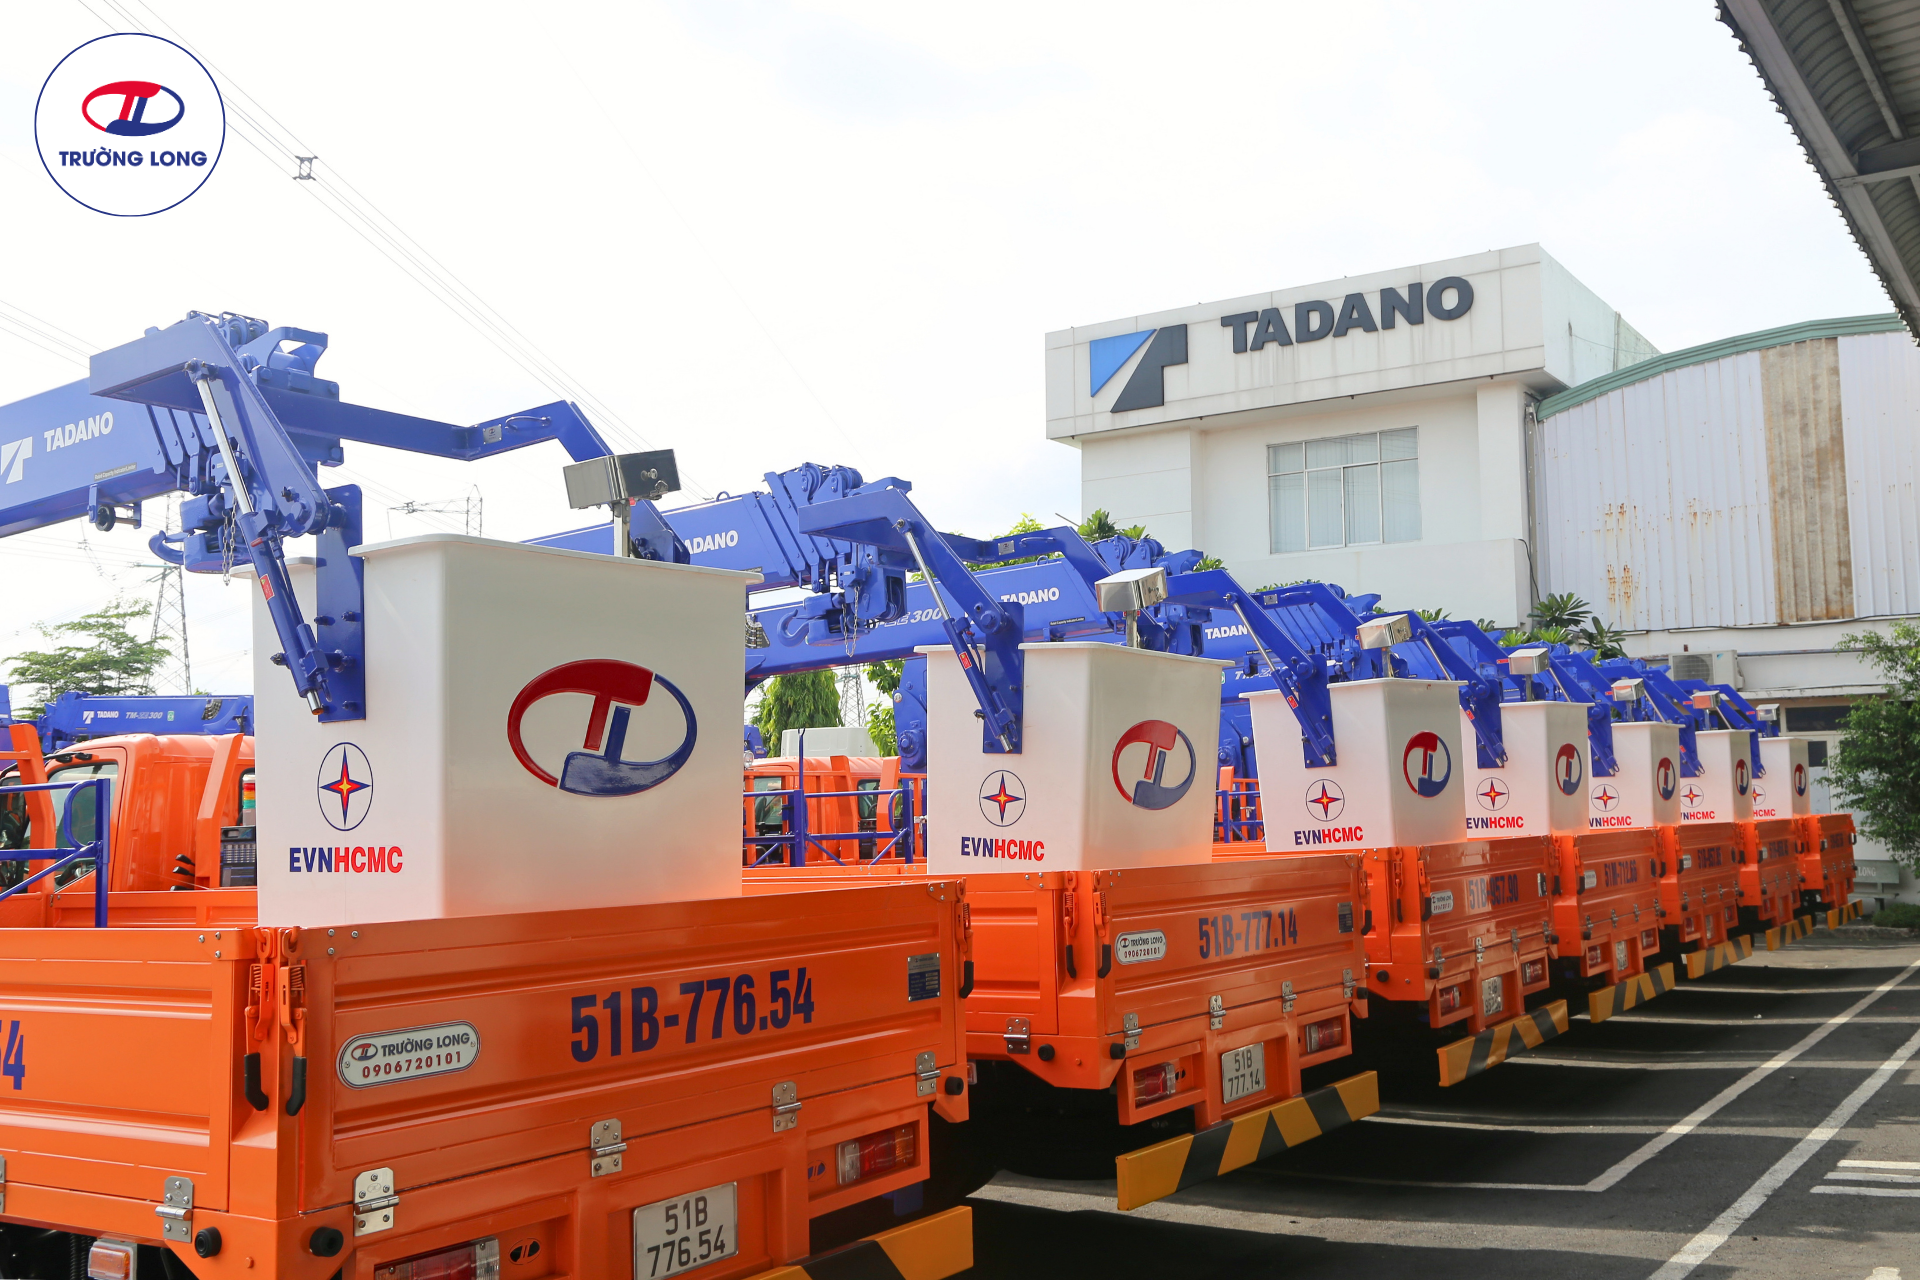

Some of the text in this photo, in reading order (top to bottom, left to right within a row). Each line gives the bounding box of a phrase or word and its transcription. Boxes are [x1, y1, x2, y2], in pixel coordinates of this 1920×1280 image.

[1220, 276, 1474, 354] TADANO
[43, 411, 114, 453] TADANO
[684, 530, 739, 555] ADANO
[1204, 624, 1249, 640] TADAN
[97, 711, 119, 719] TADANO
[1466, 816, 1524, 830] EVNHCMC
[1589, 815, 1632, 828] VNHCMC
[1681, 811, 1715, 821] NHCMC
[1753, 808, 1775, 818] HCMC
[961, 836, 1045, 862] EVNHCMC
[1294, 826, 1364, 846] EVNHCMC
[289, 846, 404, 874] EVNHCMC
[1858, 866, 1877, 877] LONG
[1468, 874, 1519, 910] 51B-957.90
[1198, 907, 1298, 960] 51B-777.14
[570, 967, 815, 1063] 51B-776.54
[0, 1019, 26, 1091] 4
[381, 1032, 470, 1057] TRƯỜNG LONG
[362, 1050, 461, 1079] 0906720101
[1234, 1049, 1253, 1073] 51B
[1227, 1068, 1261, 1098] 777.14
[664, 1195, 709, 1236] 51B
[647, 1224, 726, 1278] 776.54
